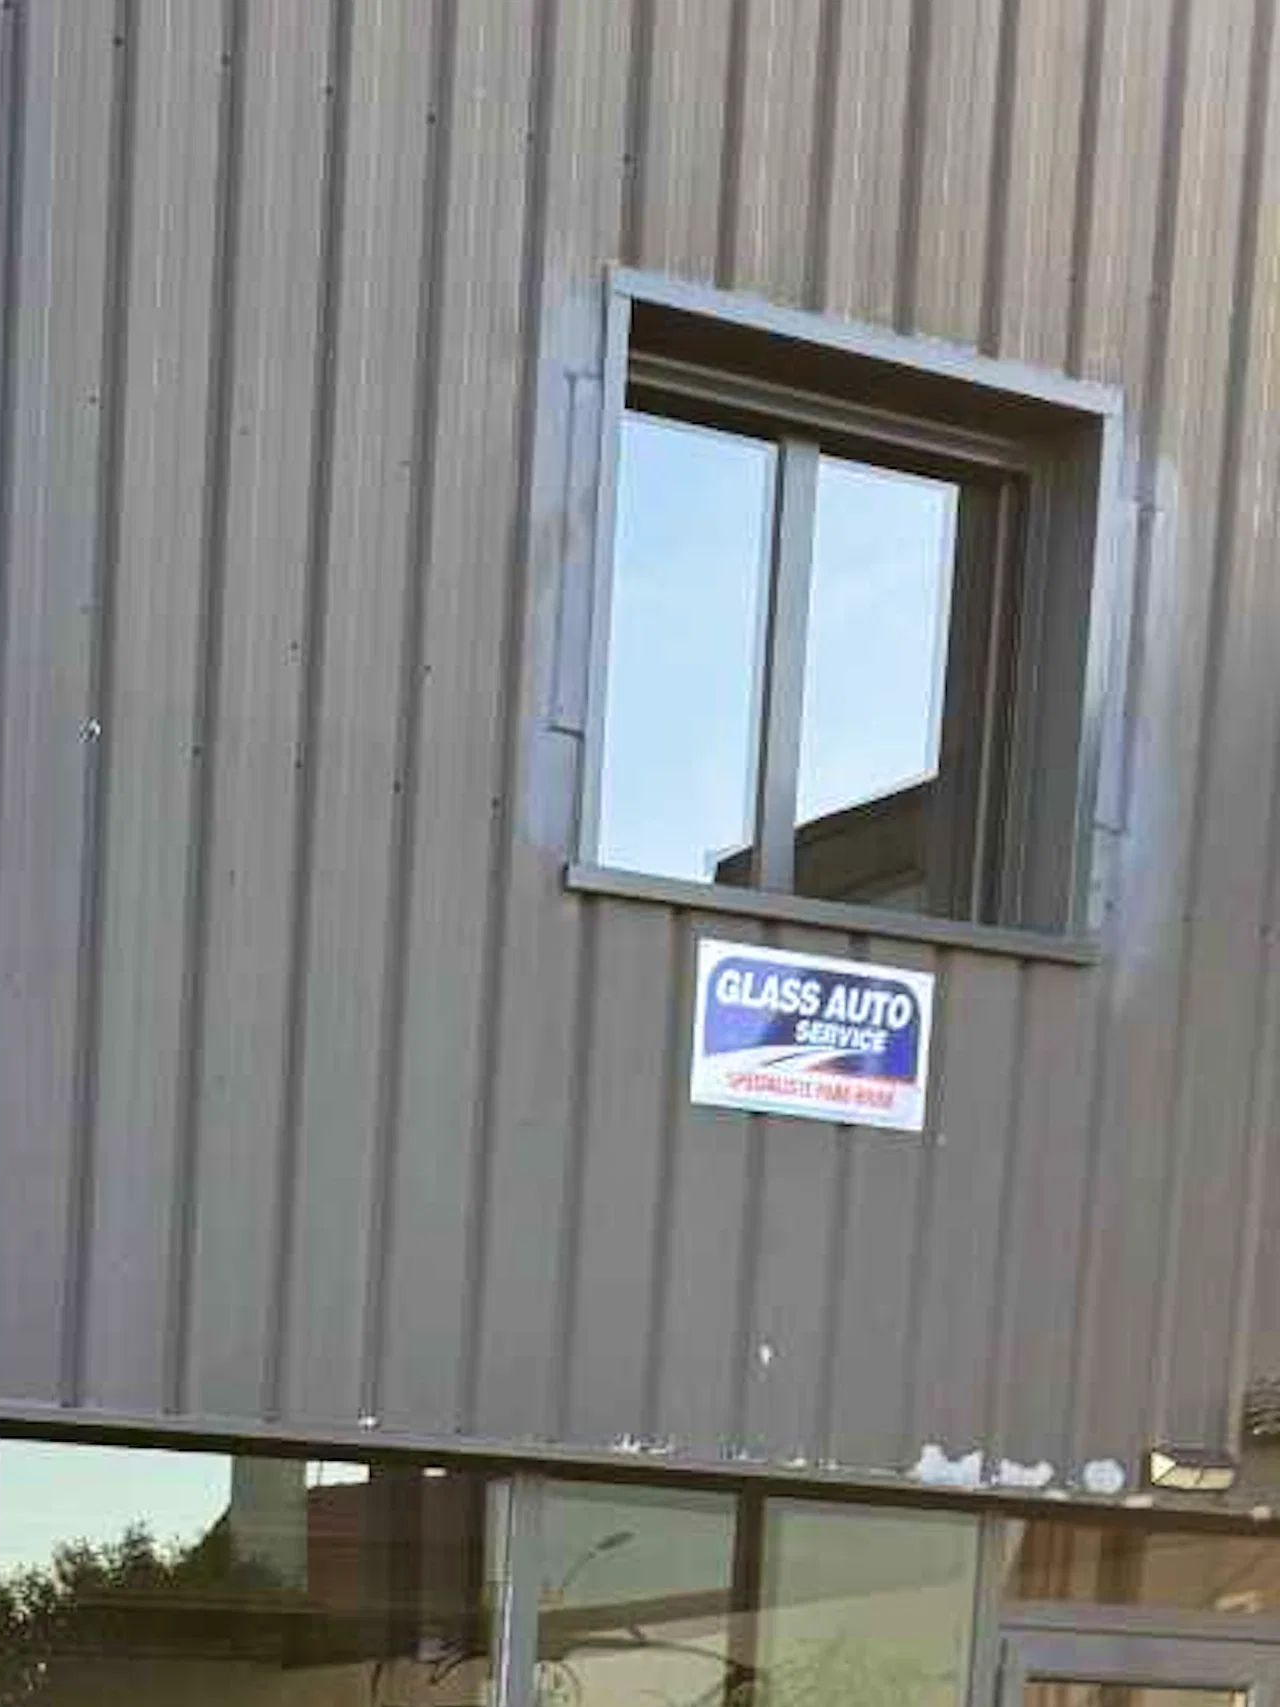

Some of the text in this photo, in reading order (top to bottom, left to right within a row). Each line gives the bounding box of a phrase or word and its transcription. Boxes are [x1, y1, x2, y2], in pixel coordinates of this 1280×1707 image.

[715, 968, 912, 1029] GLASS AUTO
[794, 1019, 889, 1051] SERVICE
